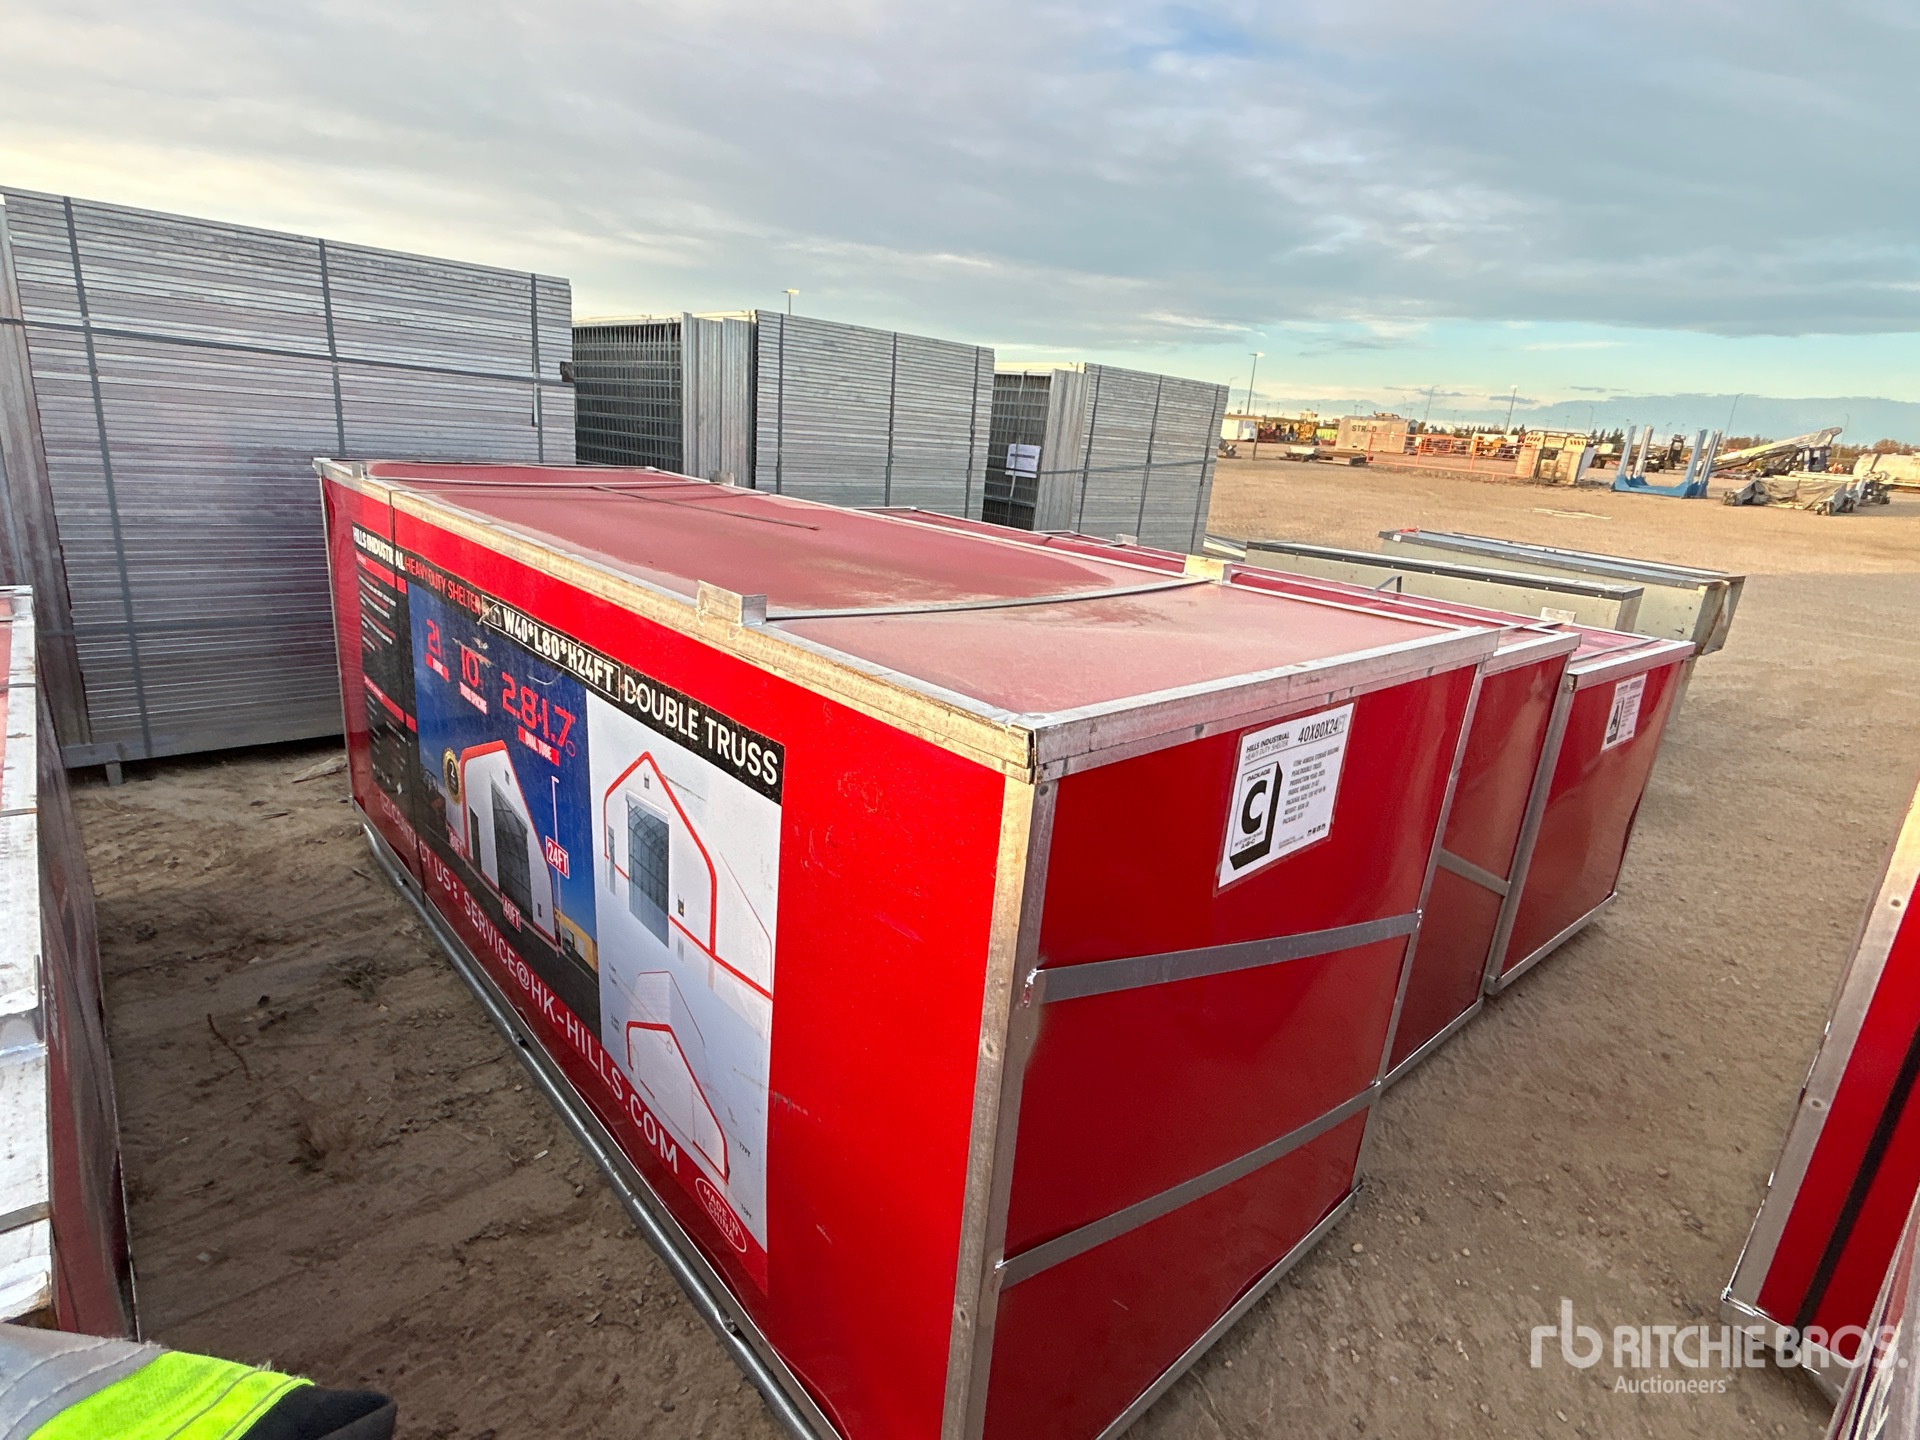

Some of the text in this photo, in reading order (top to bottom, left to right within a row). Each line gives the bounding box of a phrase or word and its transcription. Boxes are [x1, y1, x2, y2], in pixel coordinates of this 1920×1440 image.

[352, 526, 367, 549] HILLS
[367, 532, 406, 571] INDUSTRAL
[405, 556, 428, 580] HEAVY
[428, 568, 447, 595] DUTY
[447, 580, 481, 616] SHELTER
[624, 674, 700, 741] DOUBLE
[705, 717, 778, 786] TRUSS
[1609, 704, 1620, 730] A
[1245, 732, 1290, 754] HILLS INDUSTRIAL
[1246, 768, 1272, 782] PACKAGE
[1241, 780, 1268, 835] C
[547, 842, 569, 875] 24FT
[434, 857, 458, 900] US:
[464, 890, 679, 1175] SERVICE@HK-HILLS.COM
[703, 1183, 739, 1236] MADE IN
[708, 1201, 735, 1242] CHINA
